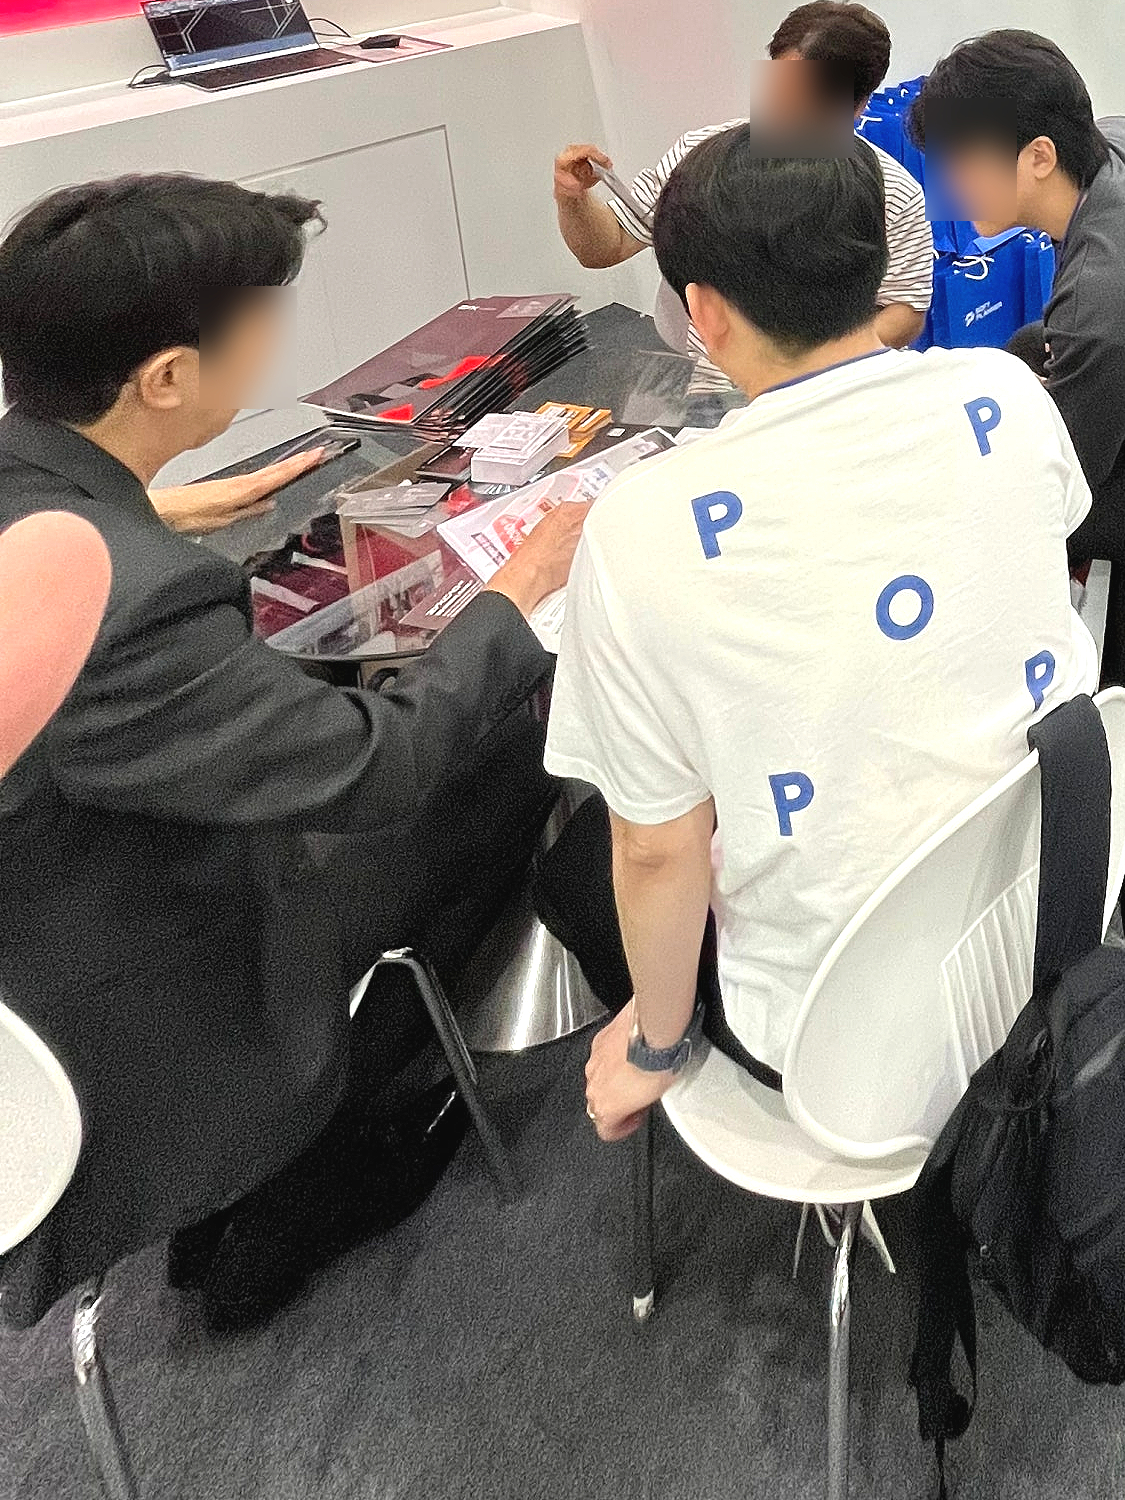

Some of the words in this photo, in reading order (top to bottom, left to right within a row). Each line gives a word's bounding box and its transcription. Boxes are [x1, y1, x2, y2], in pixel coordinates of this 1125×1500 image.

[963, 396, 1002, 457] P
[691, 490, 743, 560] P
[875, 574, 935, 641] O
[1025, 649, 1056, 712] P
[768, 771, 815, 837] P
